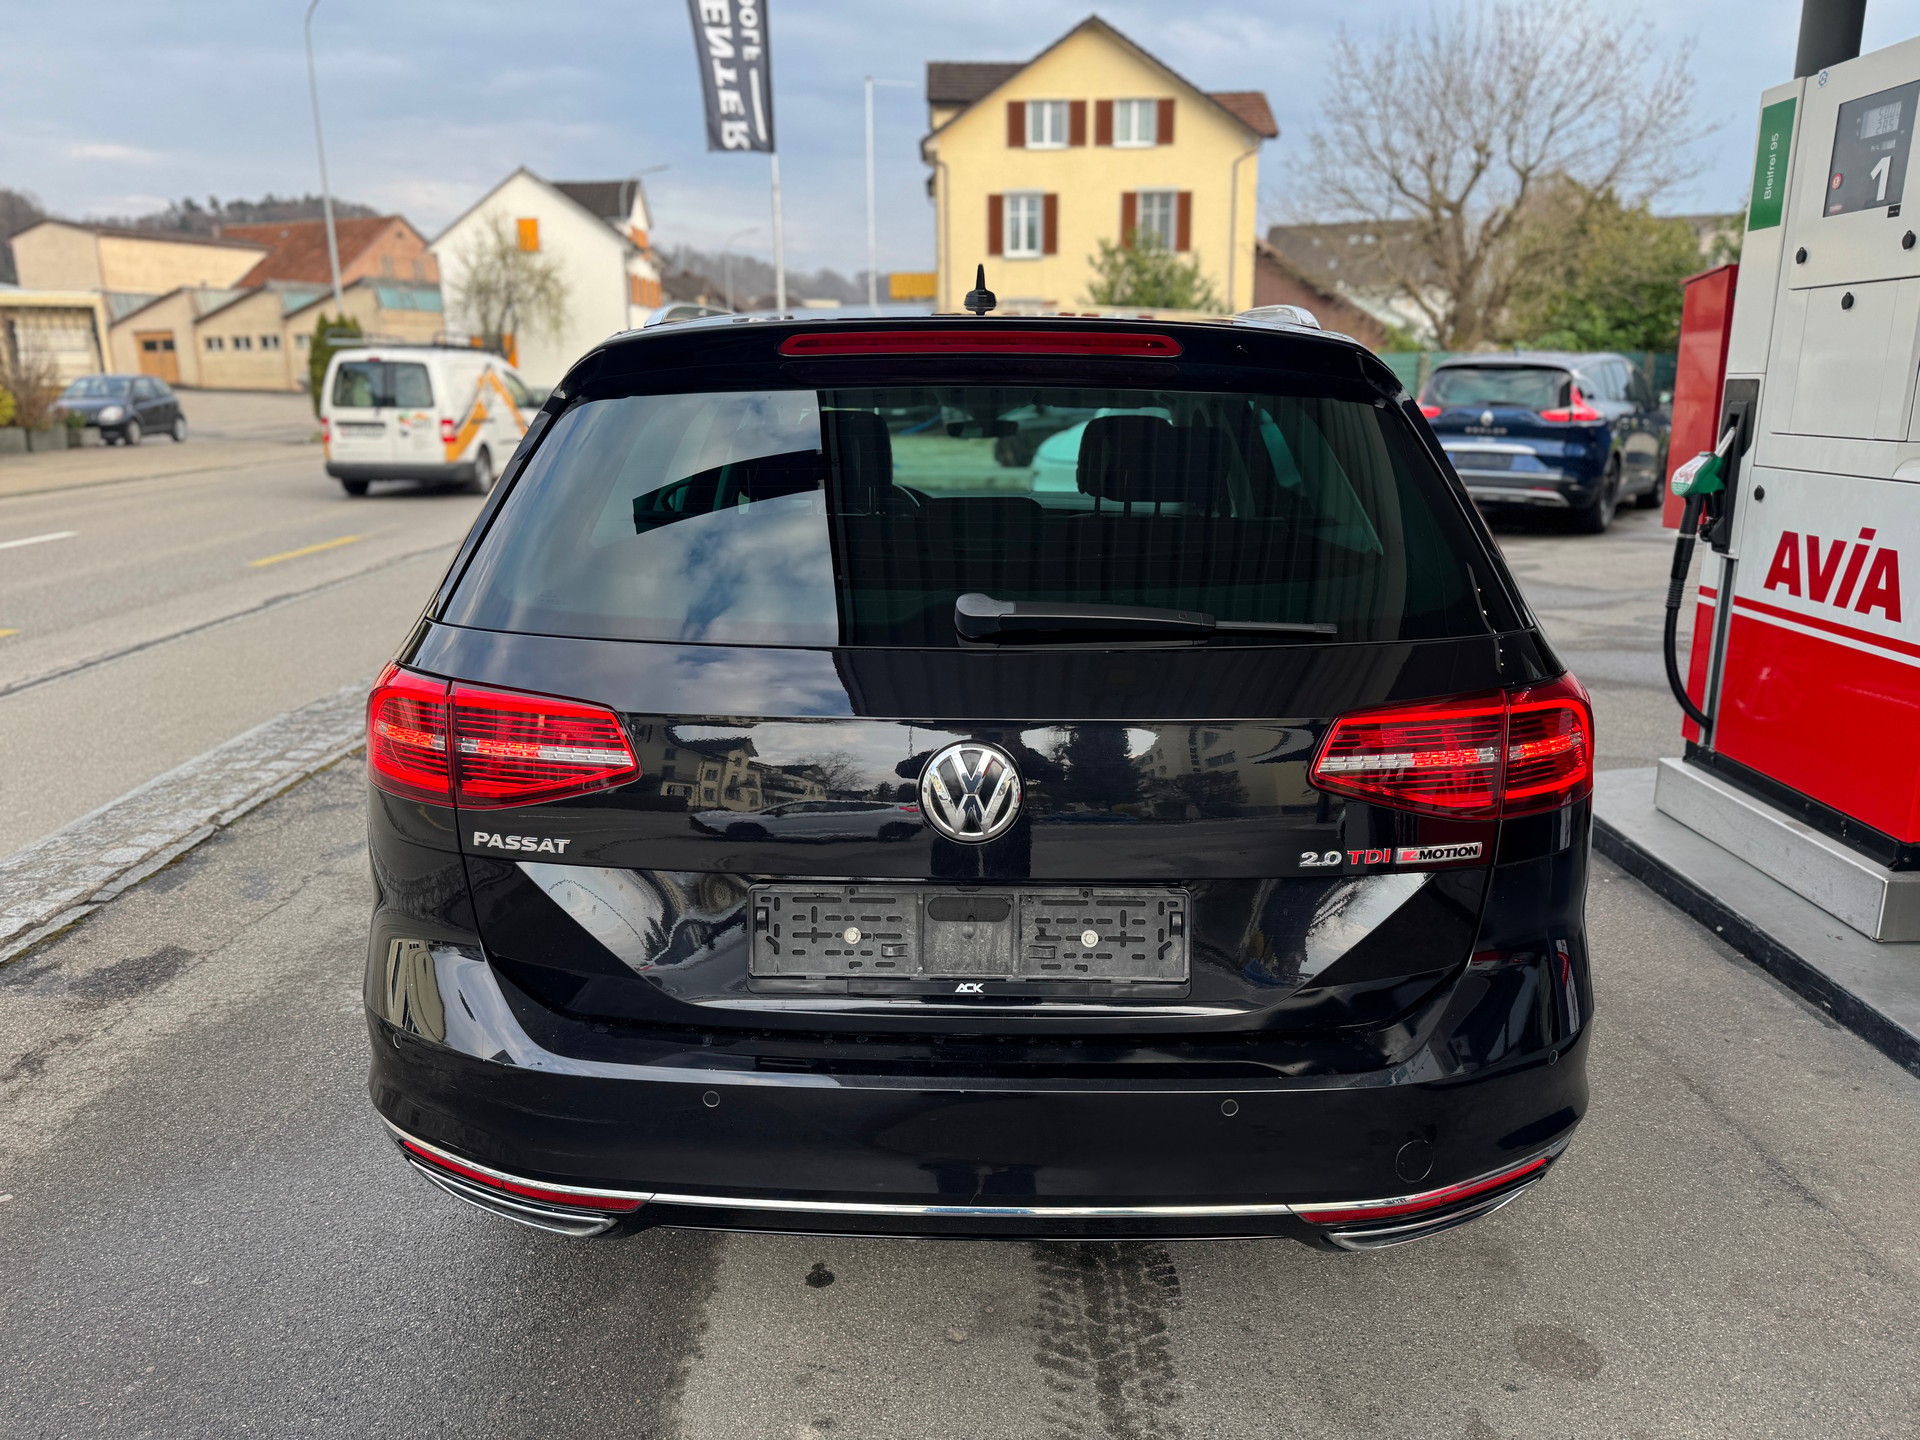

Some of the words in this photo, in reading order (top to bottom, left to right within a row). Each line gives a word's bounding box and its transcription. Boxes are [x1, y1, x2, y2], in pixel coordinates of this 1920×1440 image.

[1763, 153, 1777, 200] Bleifrei
[1770, 132, 1779, 151] 95
[1870, 155, 1892, 202] 1
[473, 831, 571, 854] PASSAT
[1300, 851, 1342, 867] 2.0
[1347, 848, 1391, 864] TDI
[954, 982, 985, 994] ACK
